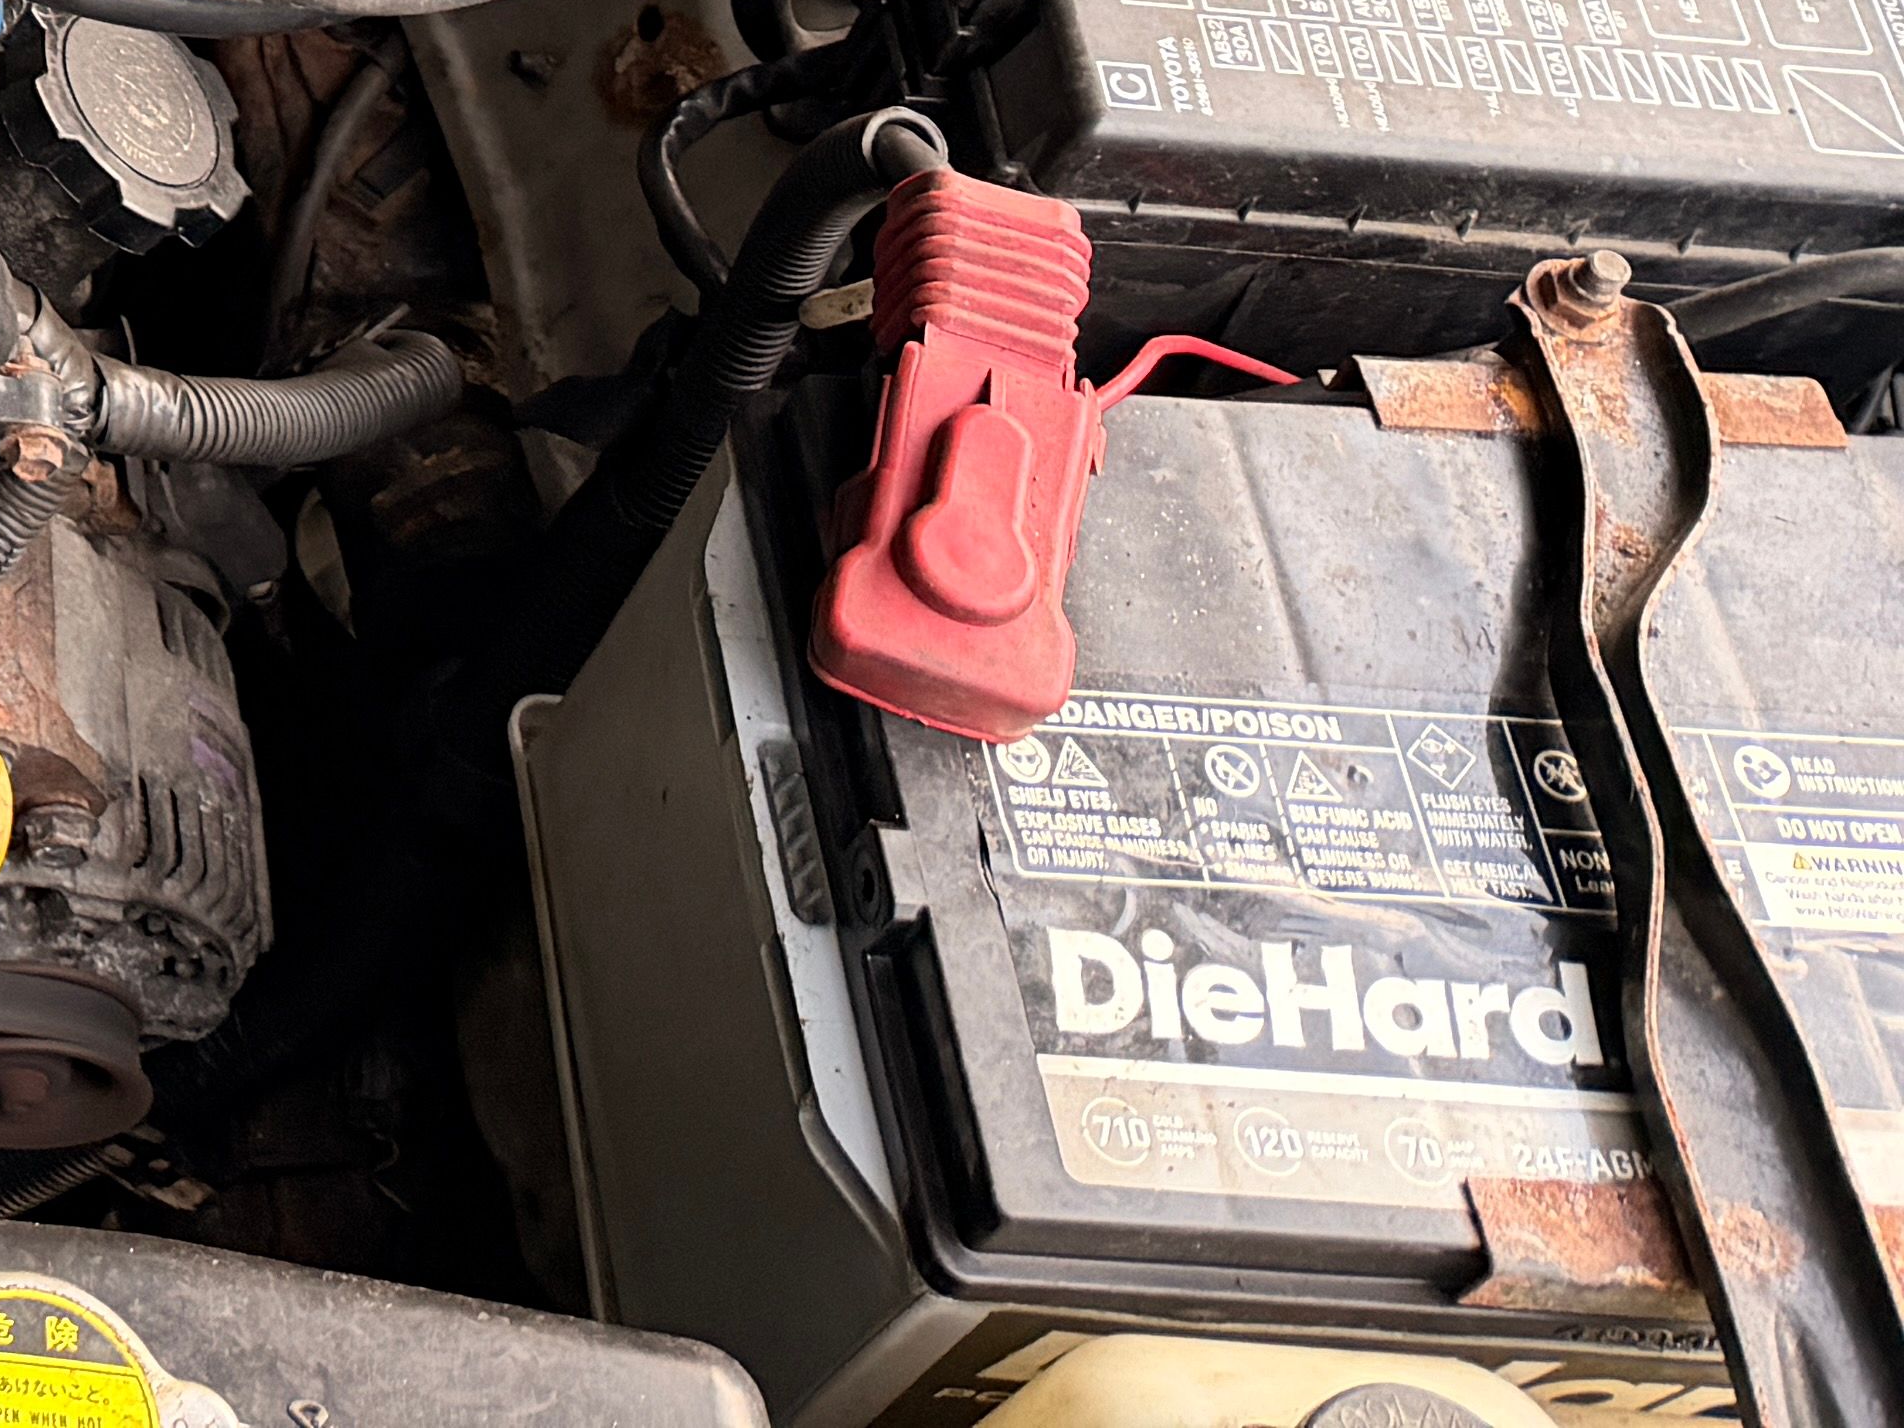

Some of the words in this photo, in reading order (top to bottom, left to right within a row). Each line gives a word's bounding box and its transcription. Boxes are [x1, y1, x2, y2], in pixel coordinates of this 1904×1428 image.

[1585, 0, 1613, 37] 20A
[1208, 19, 1234, 64] ABS2
[1228, 25, 1254, 63] 30A
[1313, 32, 1334, 67] 10A
[1351, 35, 1373, 71] 10A
[1157, 36, 1194, 114] TOYOTA
[1466, 46, 1493, 82] 10A
[1546, 51, 1572, 88] 10A
[1109, 71, 1147, 101] C
[1060, 700, 1344, 742] DANGER/POISON
[1789, 755, 1837, 776] READ
[1008, 785, 1066, 808] SHIELD
[1070, 789, 1119, 812] EYES.
[1193, 795, 1219, 818] NO
[1421, 792, 1471, 813] FLUSH
[1472, 795, 1512, 815] EYES
[1014, 810, 1105, 835] EXPLOSIVE
[1107, 815, 1162, 838] GASES
[1289, 803, 1370, 830] SULFURIC
[1373, 810, 1414, 832] ACID
[1426, 811, 1526, 833] IMMEDIATELY
[1775, 817, 1807, 841] DO
[1807, 819, 1847, 843] NOT
[1022, 829, 1052, 847] CAN
[1055, 831, 1104, 850] CAUSE
[1211, 821, 1271, 842] SPARKS
[1295, 826, 1330, 846] CAN
[1331, 828, 1380, 849] CAUSE
[1432, 829, 1480, 848] WITH
[1481, 832, 1534, 851] WATER.
[1027, 847, 1050, 866] OR
[1052, 849, 1111, 871] INJURY.
[1218, 843, 1278, 863] FLAMES
[1301, 846, 1386, 871] BLINDNESS
[1387, 853, 1412, 871] OR
[1812, 854, 1904, 876] WARNIN
[1307, 867, 1367, 888] SEVERE
[1443, 858, 1474, 878] GET
[1450, 877, 1491, 896] HELP
[1492, 882, 1534, 900] FAST.
[1045, 926, 1605, 1067] DieHard
[1092, 1114, 1152, 1150] 710
[1243, 1125, 1306, 1160] 120
[1311, 1145, 1370, 1162] CAPACITY
[1397, 1135, 1445, 1168] 70
[30, 1412, 69, 1428] WHEN
